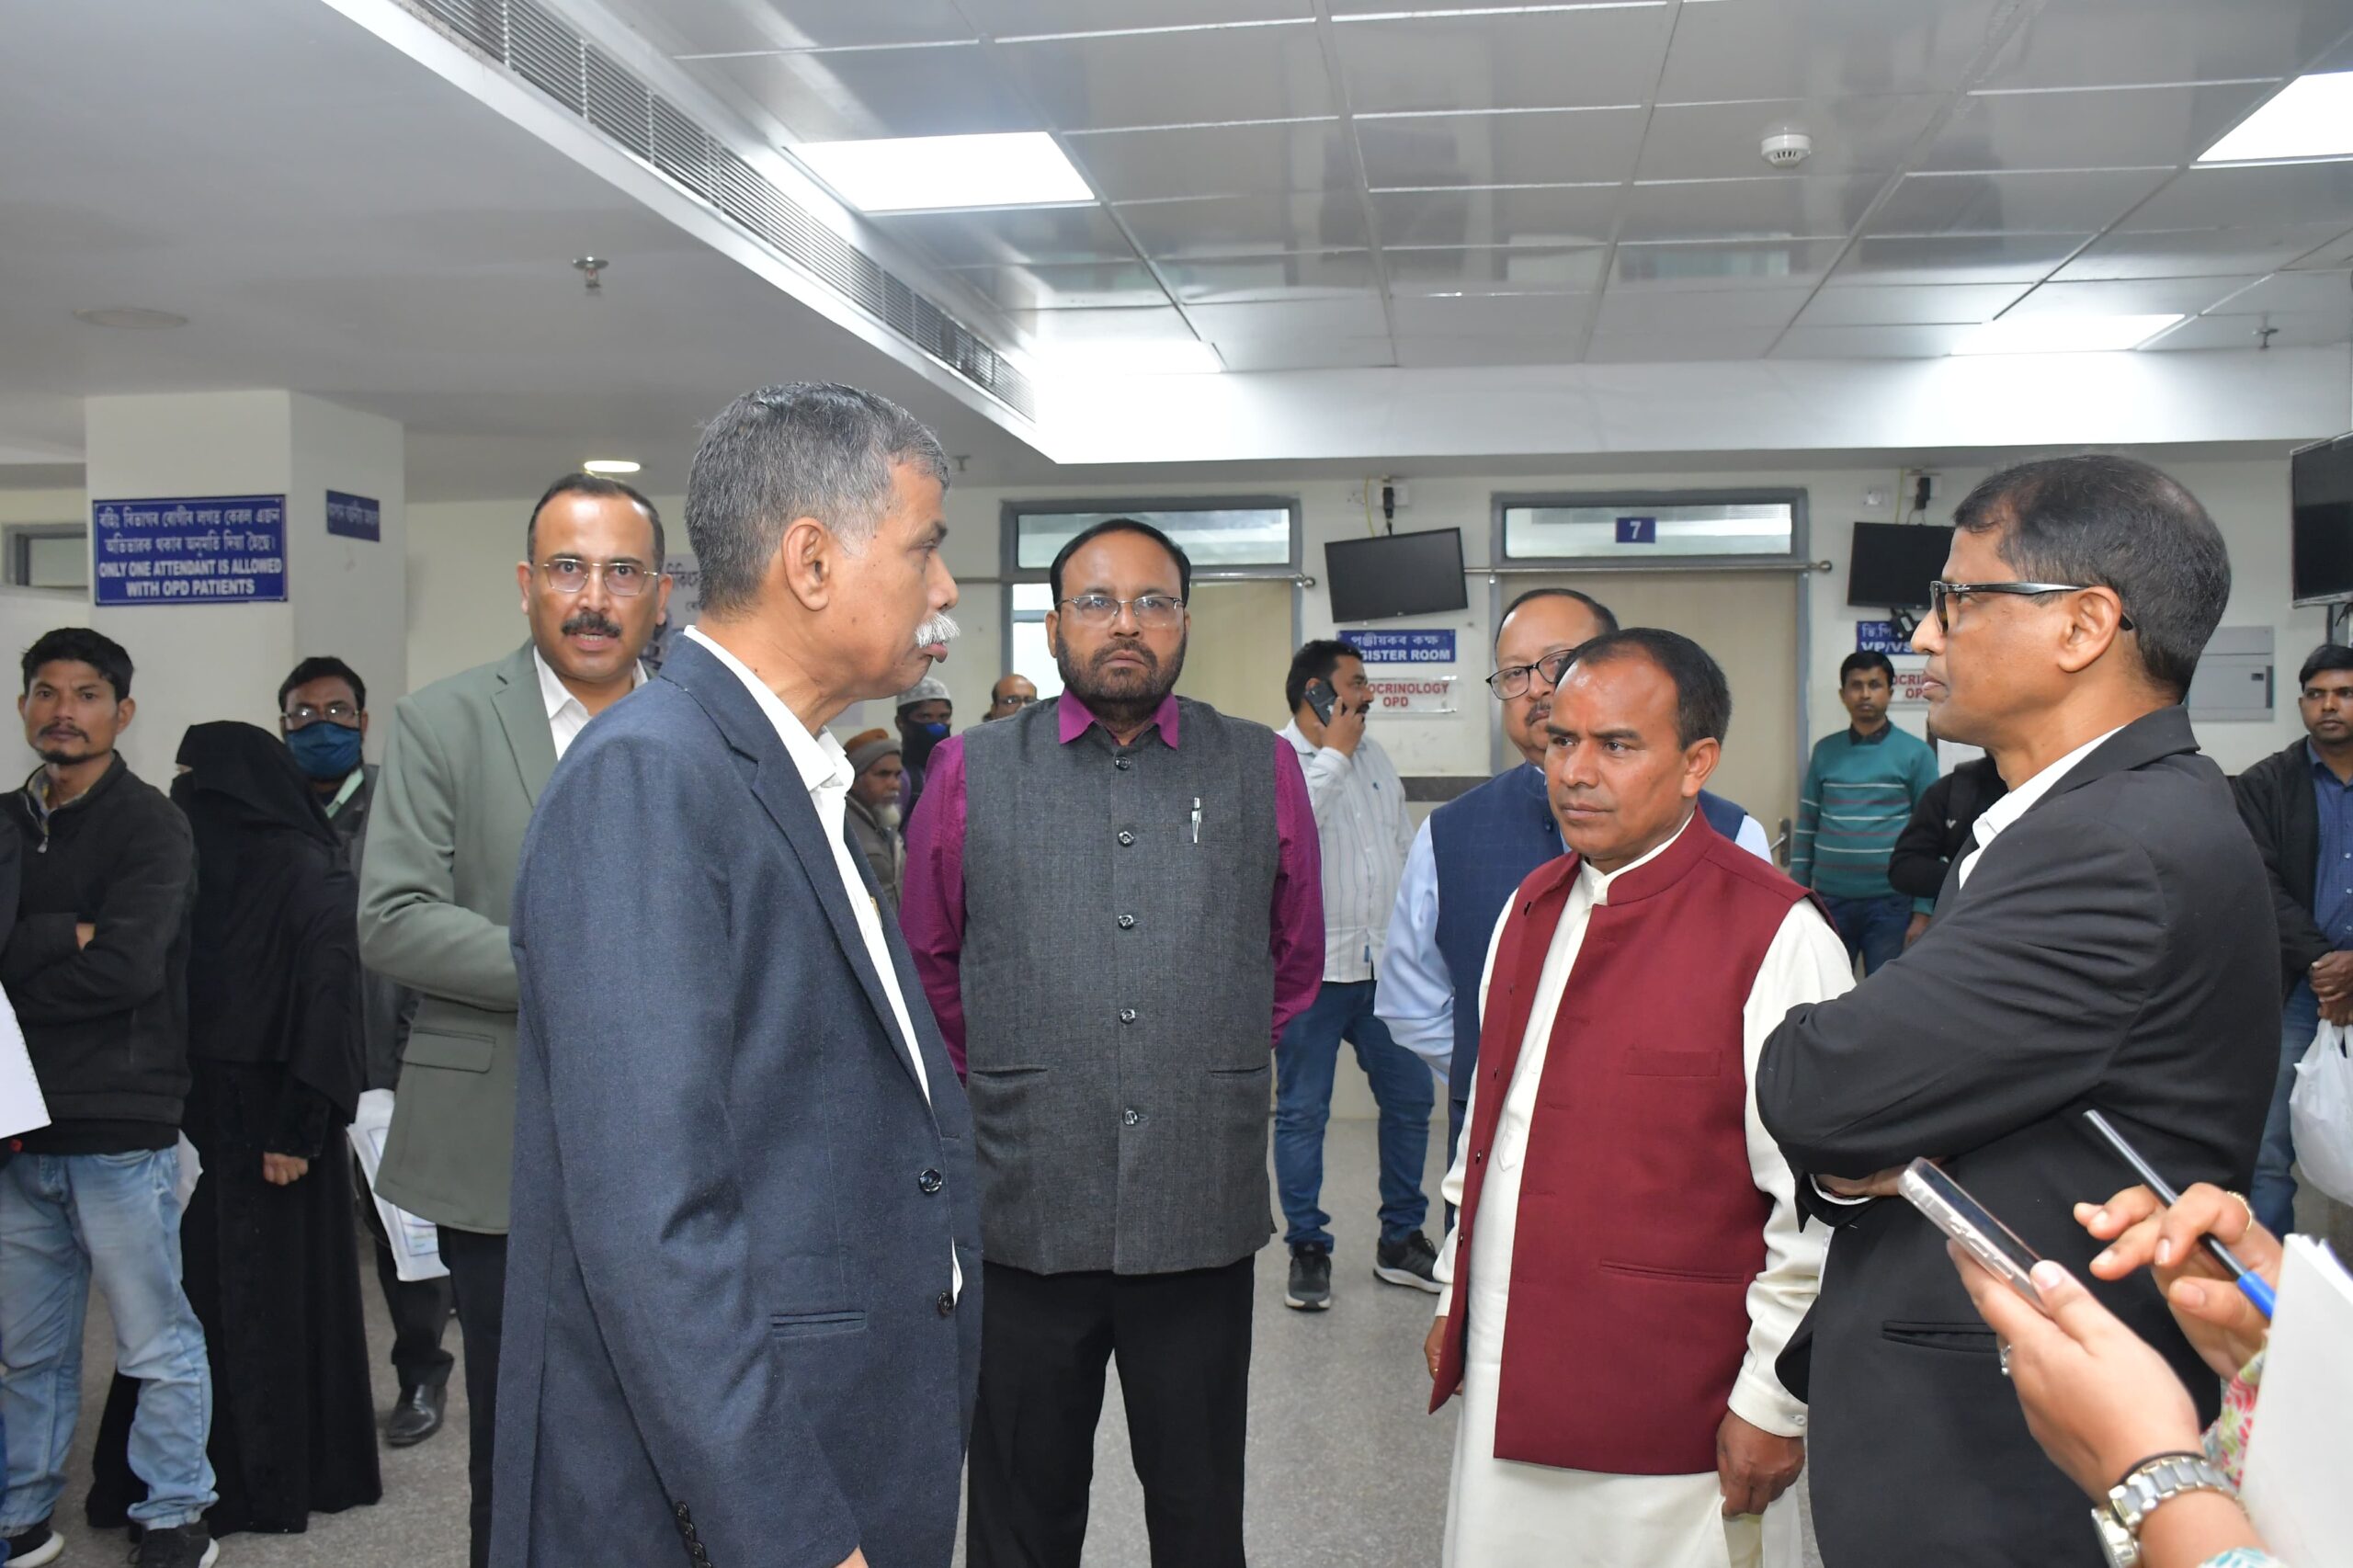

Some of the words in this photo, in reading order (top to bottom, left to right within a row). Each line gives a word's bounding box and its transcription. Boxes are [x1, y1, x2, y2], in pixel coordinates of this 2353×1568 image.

[1630, 520, 1642, 540] 7
[98, 562, 127, 578] ONLY
[128, 561, 152, 577] ONE
[153, 559, 216, 576] ATTENDANT
[218, 559, 230, 574] IS
[231, 558, 282, 574] ALLOWED
[126, 581, 160, 597] WITH
[162, 580, 189, 596] OPD
[192, 579, 256, 596] PATIENTS
[1360, 649, 1407, 661] GISTER
[1410, 649, 1450, 661] ROOM
[1368, 683, 1449, 695] OCRINOLOGY
[1905, 687, 1923, 699] OP
[1382, 697, 1409, 708] OPD
